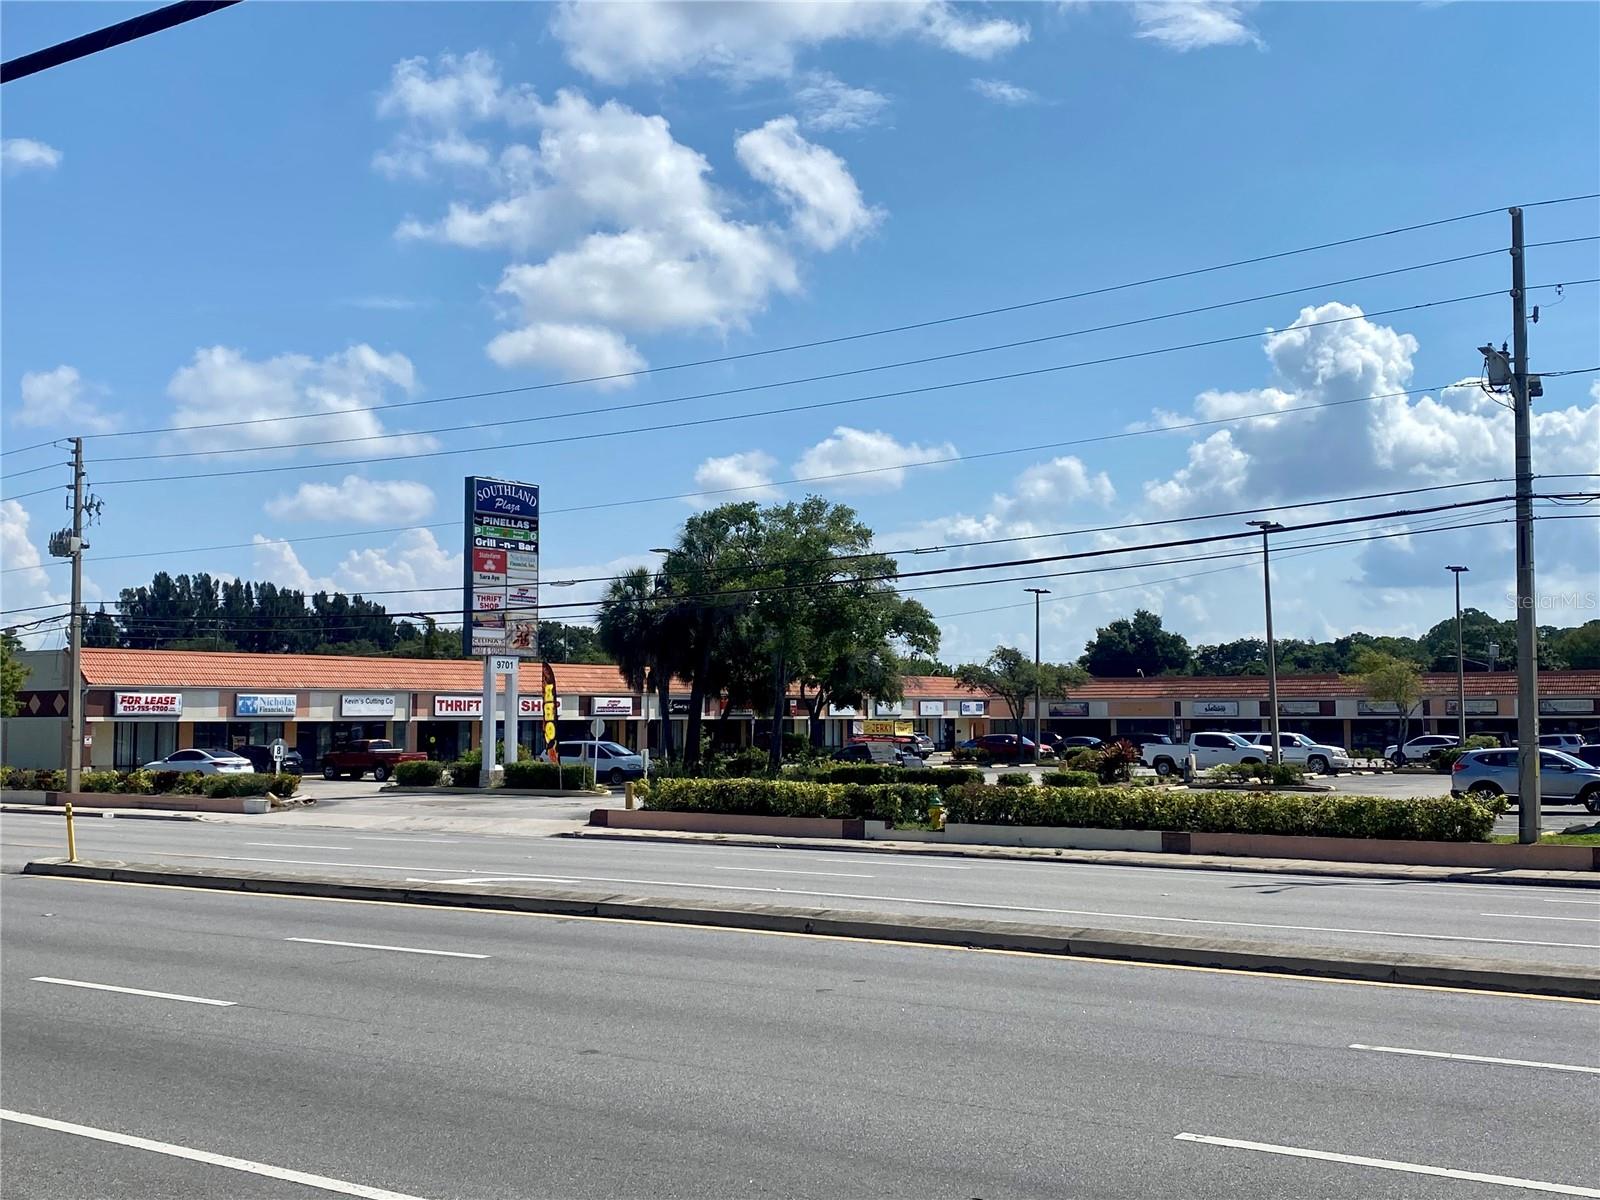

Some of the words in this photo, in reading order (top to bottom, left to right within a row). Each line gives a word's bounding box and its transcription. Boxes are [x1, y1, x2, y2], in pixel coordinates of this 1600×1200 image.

[477, 484, 537, 507] SOUTHLAND
[495, 498, 520, 513] Plaza
[483, 517, 529, 528] PINELLAS
[475, 537, 496, 547] Grill
[518, 542, 536, 551] Bar
[479, 602, 500, 610] SHOP
[496, 660, 514, 669] 9701
[120, 696, 142, 705] FOR
[145, 696, 177, 705] LEASE
[259, 697, 295, 706] Nicholas
[365, 698, 385, 706] Cutting
[436, 699, 482, 712] THRIFT
[521, 700, 561, 713] SHP
[871, 723, 893, 733] JERKY
[276, 746, 281, 754] 8
